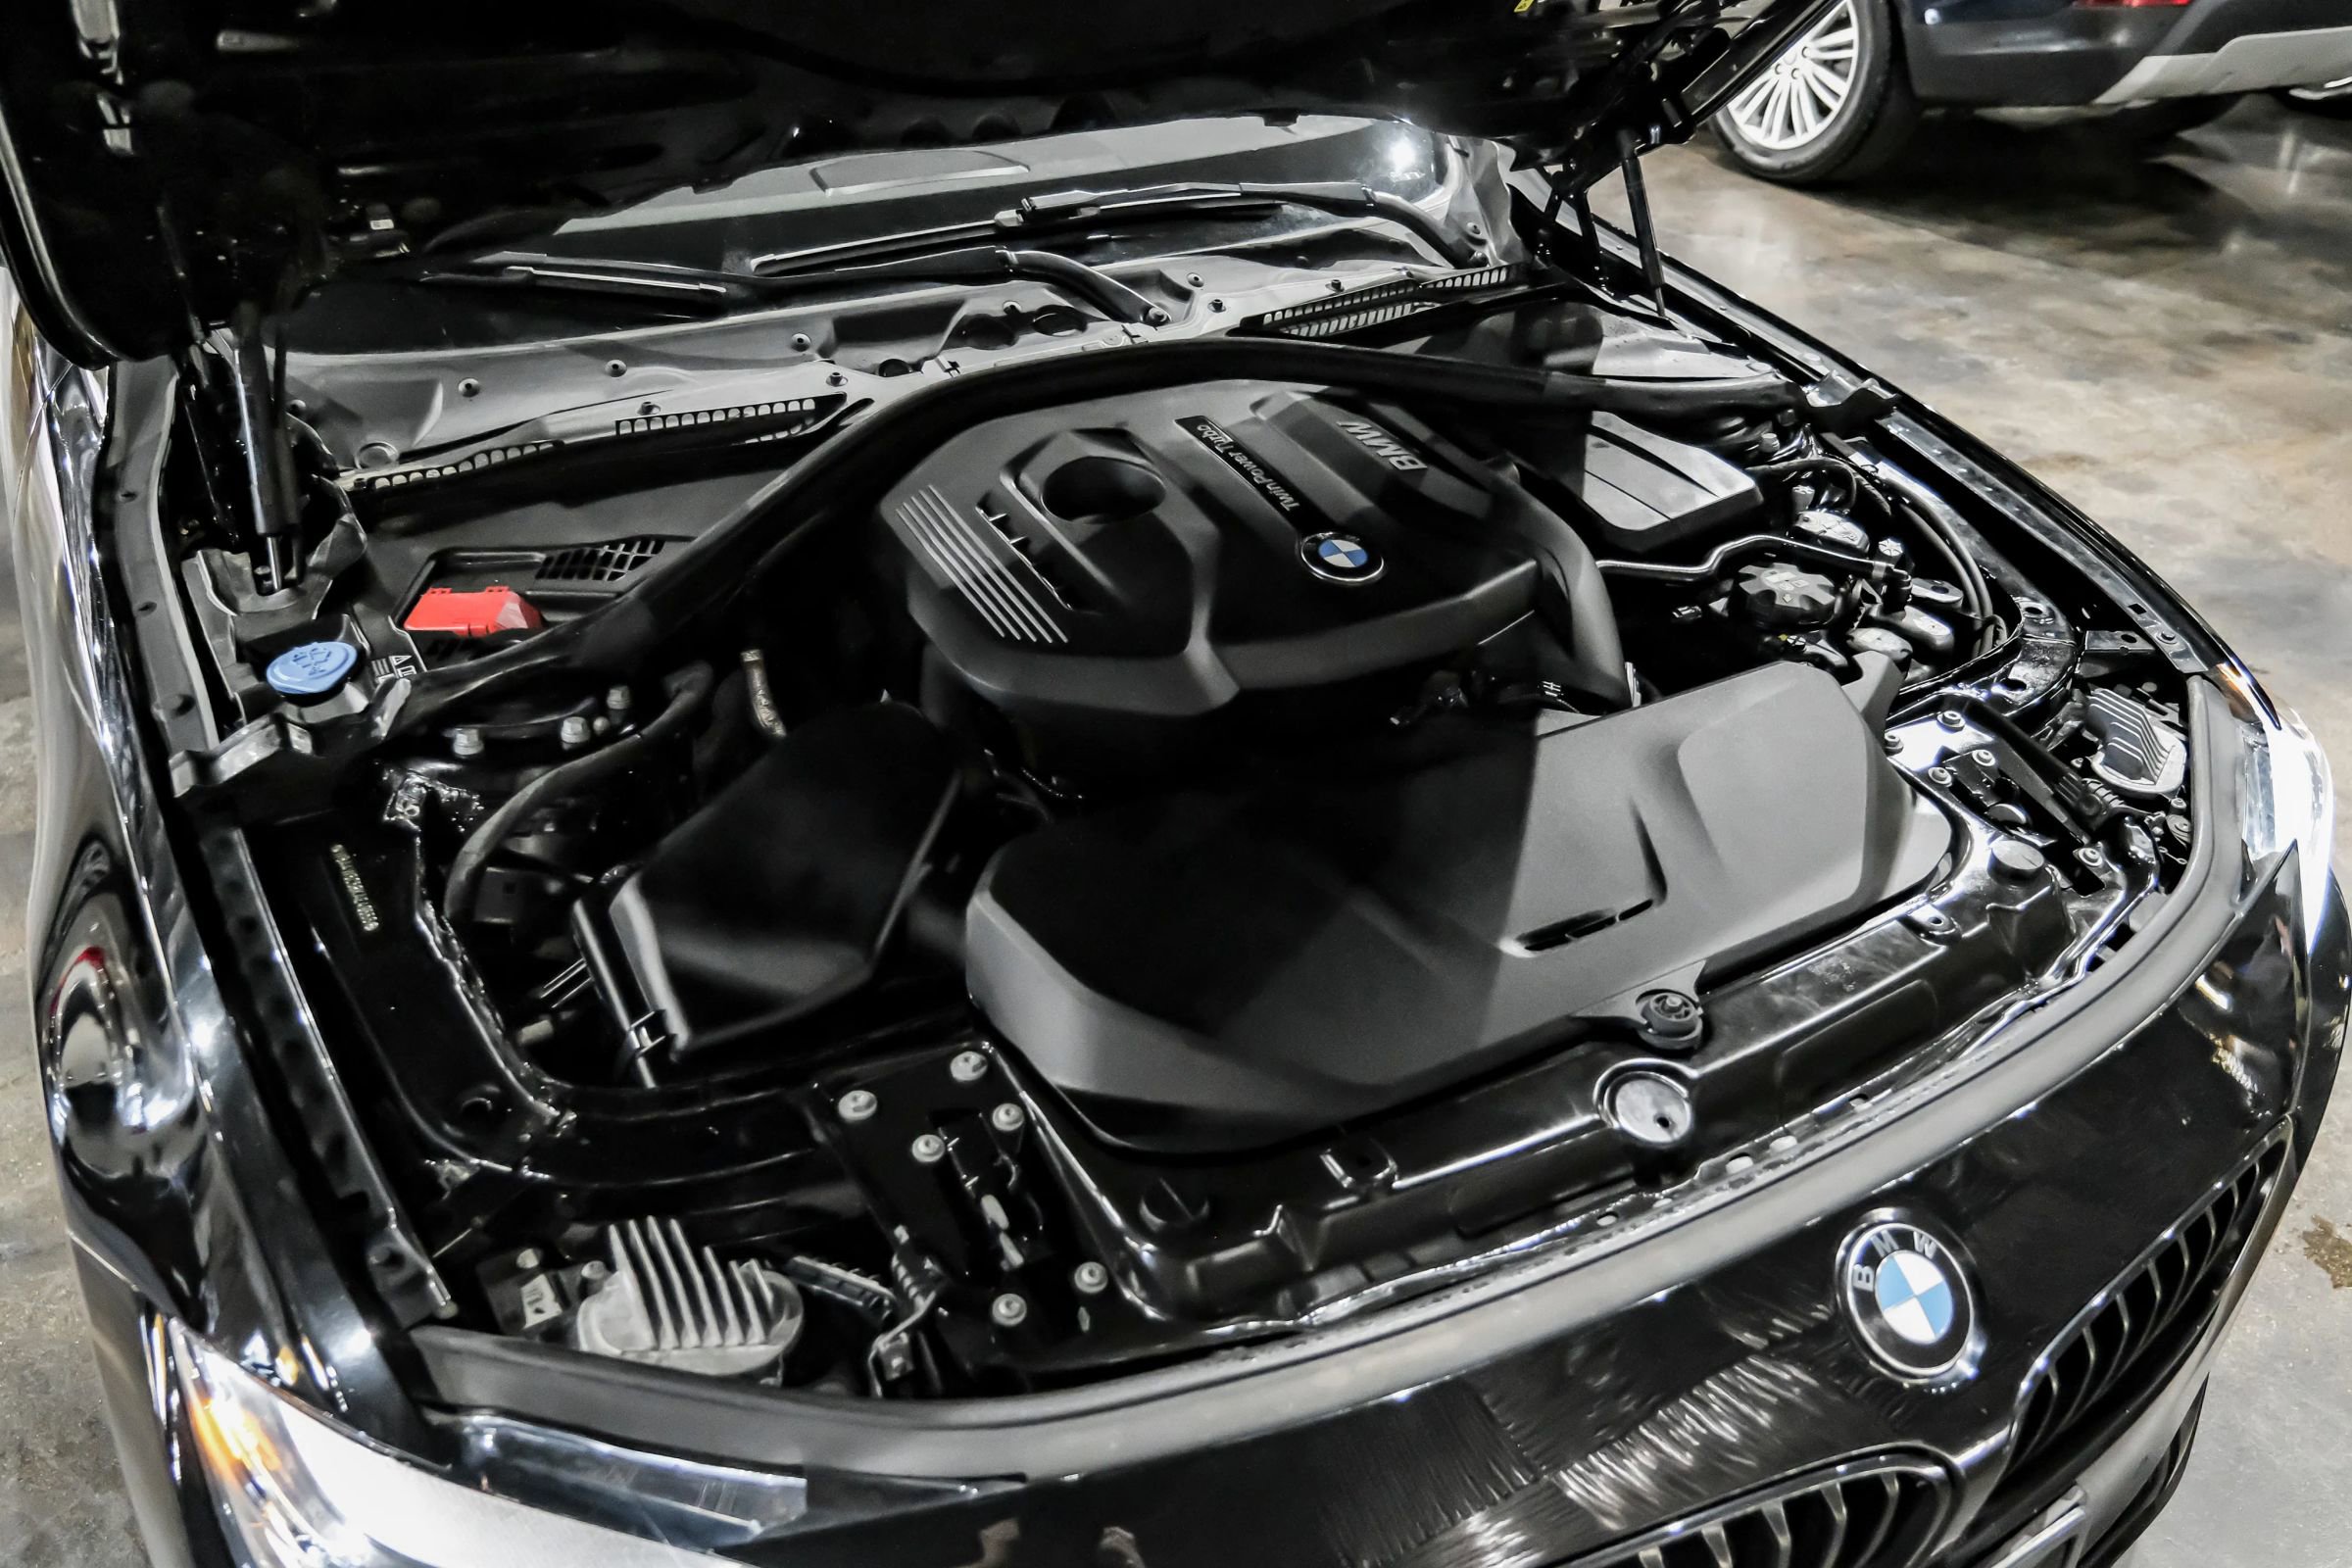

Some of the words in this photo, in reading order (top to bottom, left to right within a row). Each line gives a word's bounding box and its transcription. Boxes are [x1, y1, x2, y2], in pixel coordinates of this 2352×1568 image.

[1196, 423, 1235, 454] Turbo
[1336, 420, 1428, 470] BMW
[1229, 448, 1301, 512] TwinPower
[1852, 1229, 1937, 1292] BMW
